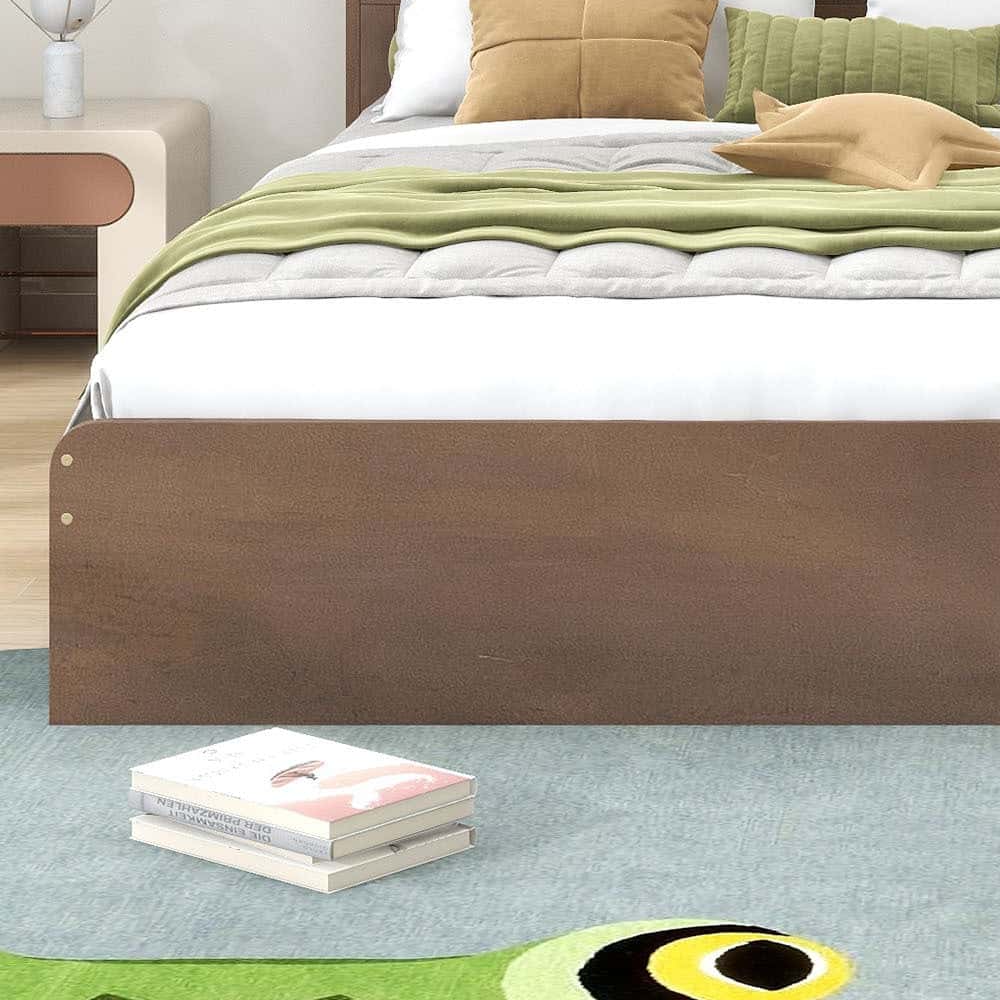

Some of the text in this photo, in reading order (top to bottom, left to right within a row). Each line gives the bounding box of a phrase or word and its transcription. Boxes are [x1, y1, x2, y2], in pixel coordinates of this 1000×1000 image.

[156, 797, 272, 834] DER PRIMZAHLEN
[253, 831, 272, 844] DIE
